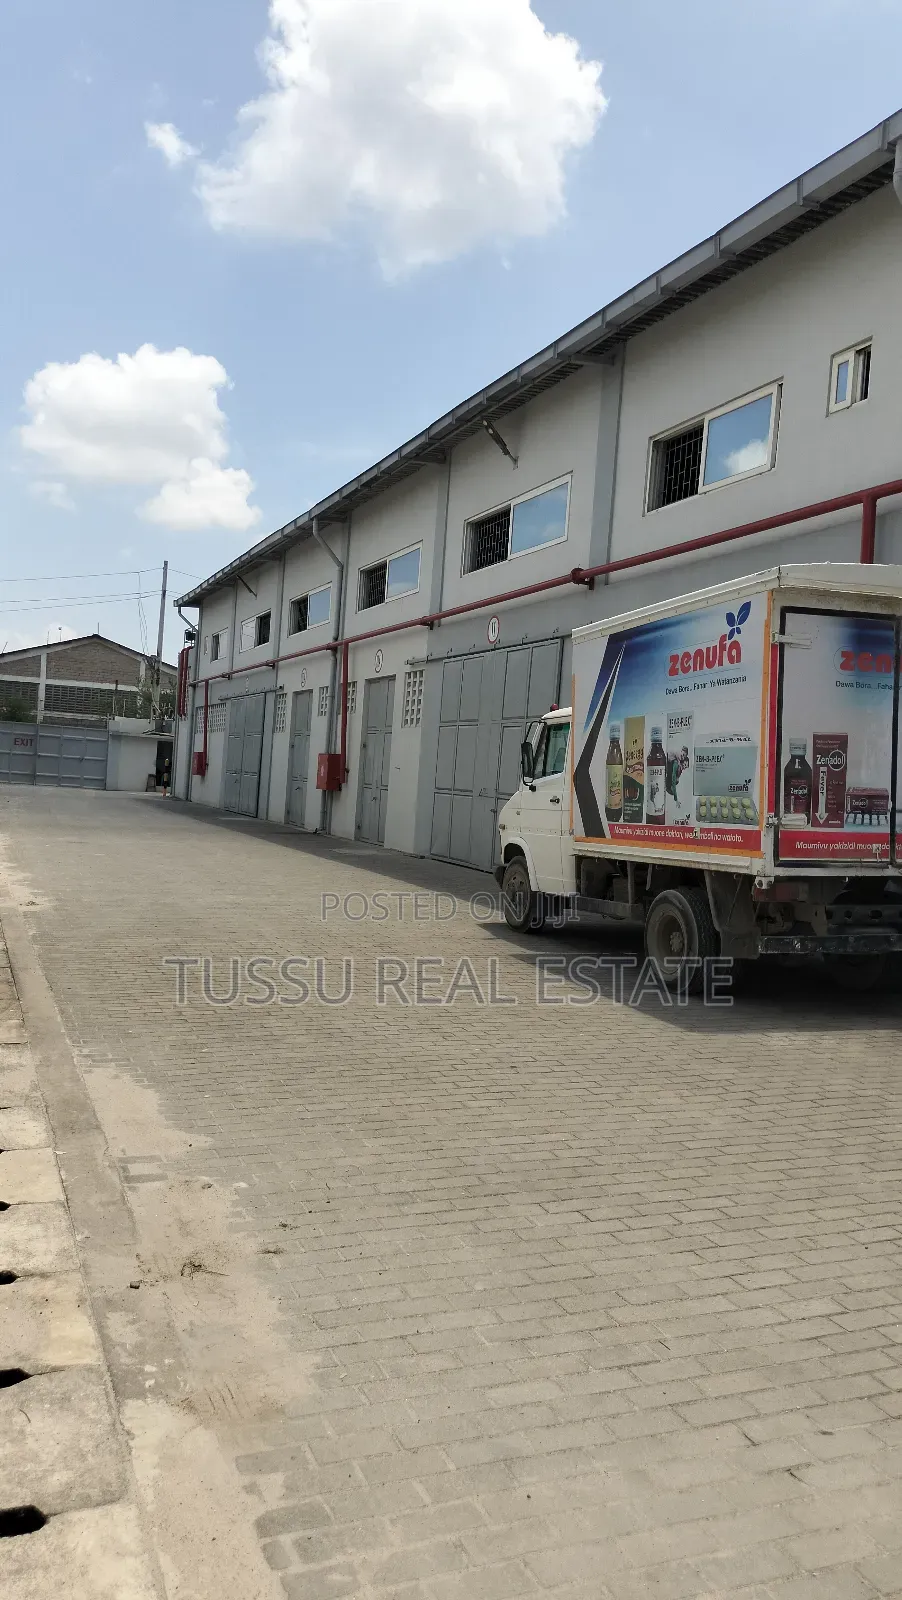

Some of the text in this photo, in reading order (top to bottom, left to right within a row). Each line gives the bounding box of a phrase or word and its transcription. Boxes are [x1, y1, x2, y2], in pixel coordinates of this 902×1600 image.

[668, 634, 741, 676] zenufa
[14, 737, 34, 746] EXIT
[816, 754, 845, 765] Zenadol
[829, 842, 855, 852] yakizidi
